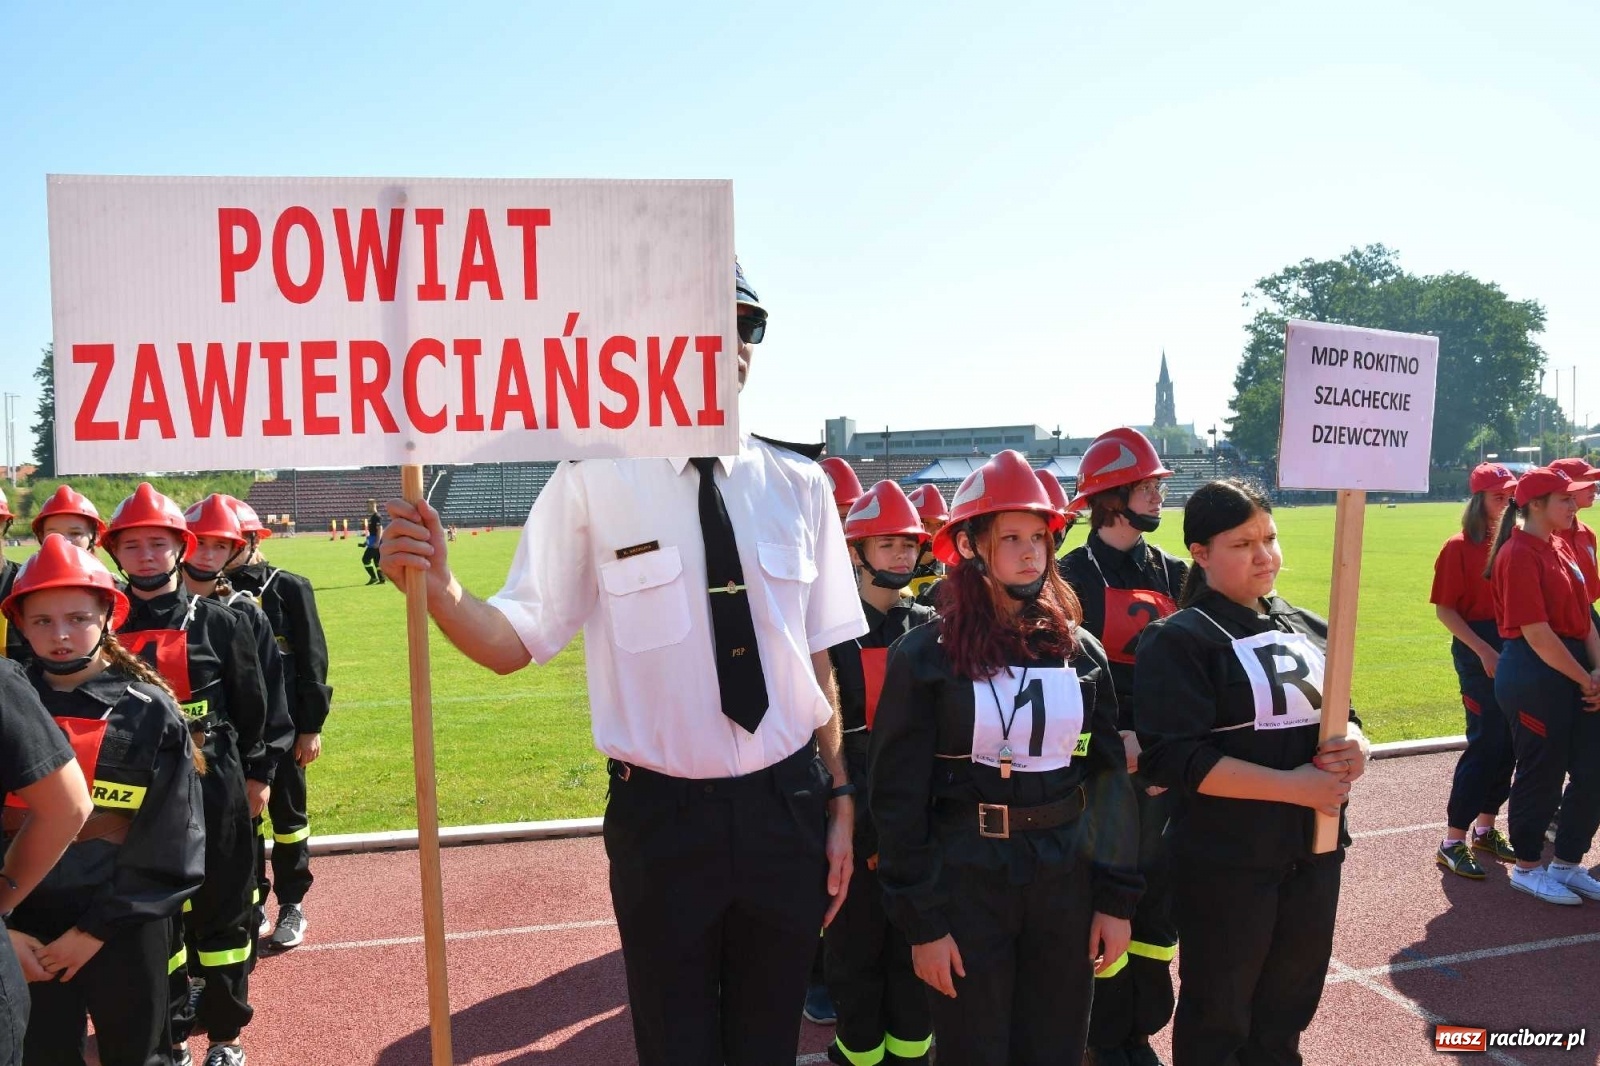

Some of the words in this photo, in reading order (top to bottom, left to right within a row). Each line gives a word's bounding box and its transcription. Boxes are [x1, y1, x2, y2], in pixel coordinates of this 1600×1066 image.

[217, 206, 552, 304] POWIAT
[72, 312, 725, 441] ZAWIERCIAŃSKI
[1311, 346, 1349, 367] MDP
[1353, 351, 1419, 375] ROKITNO
[1314, 385, 1411, 411] SZLACHECKIE
[1312, 424, 1409, 448] DZIEWCZYNY
[1121, 601, 1159, 656] 2
[1252, 643, 1323, 716] R
[1014, 678, 1046, 757] 1
